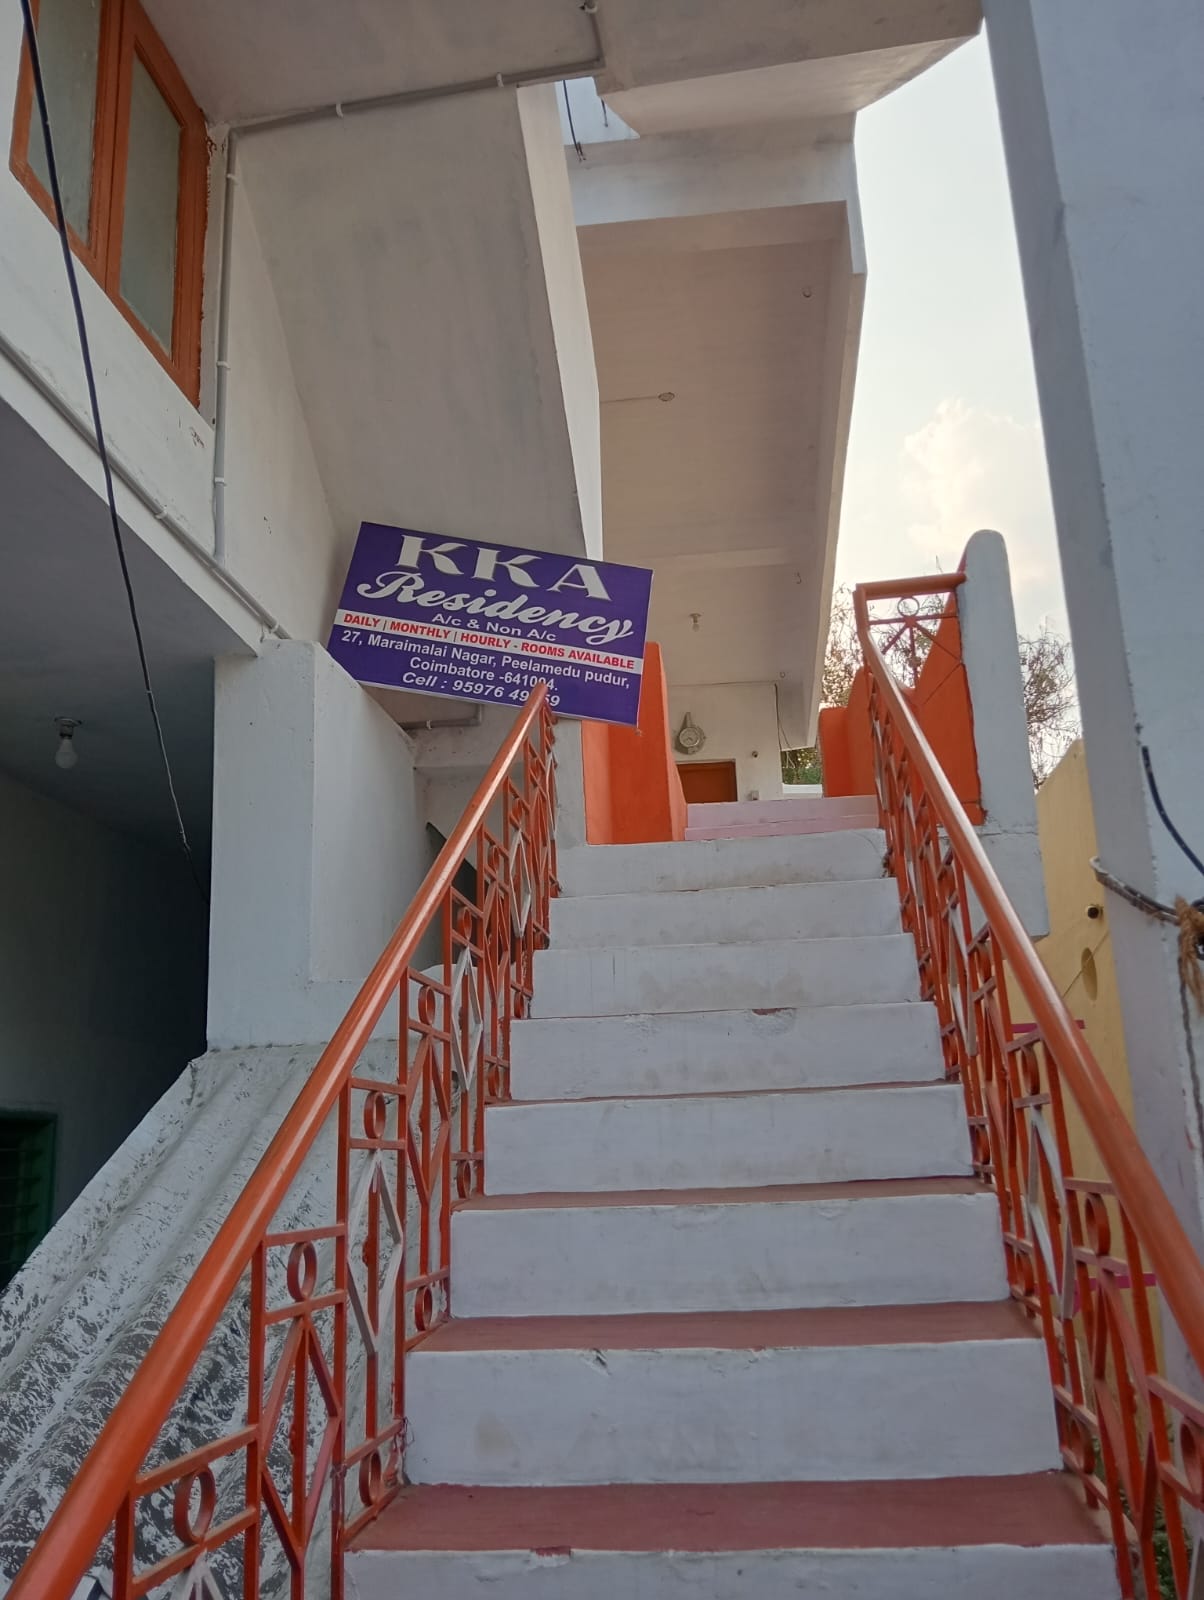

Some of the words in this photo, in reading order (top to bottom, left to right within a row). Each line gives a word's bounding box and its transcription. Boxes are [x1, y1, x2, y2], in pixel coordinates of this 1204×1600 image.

[394, 534, 613, 602] KKA
[356, 570, 634, 645] Residency
[431, 613, 463, 626] A/c
[467, 618, 480, 629] &
[486, 621, 521, 636] Non
[527, 628, 557, 642] A/c
[341, 629, 363, 646] 27,
[367, 633, 447, 658] Maraimalai
[450, 647, 497, 667] Nagar,
[501, 655, 581, 679] Peelamedu
[584, 669, 630, 689] pudur,
[343, 613, 380, 628] DAILY
[389, 620, 451, 640] MONTHLY
[460, 632, 512, 649] HOURLY
[520, 642, 565, 657] ROOMS
[567, 649, 635, 670] AVAILABLE
[410, 656, 495, 681] Coimbatore
[402, 671, 438, 688] Cell
[452, 679, 505, 698] 95976
